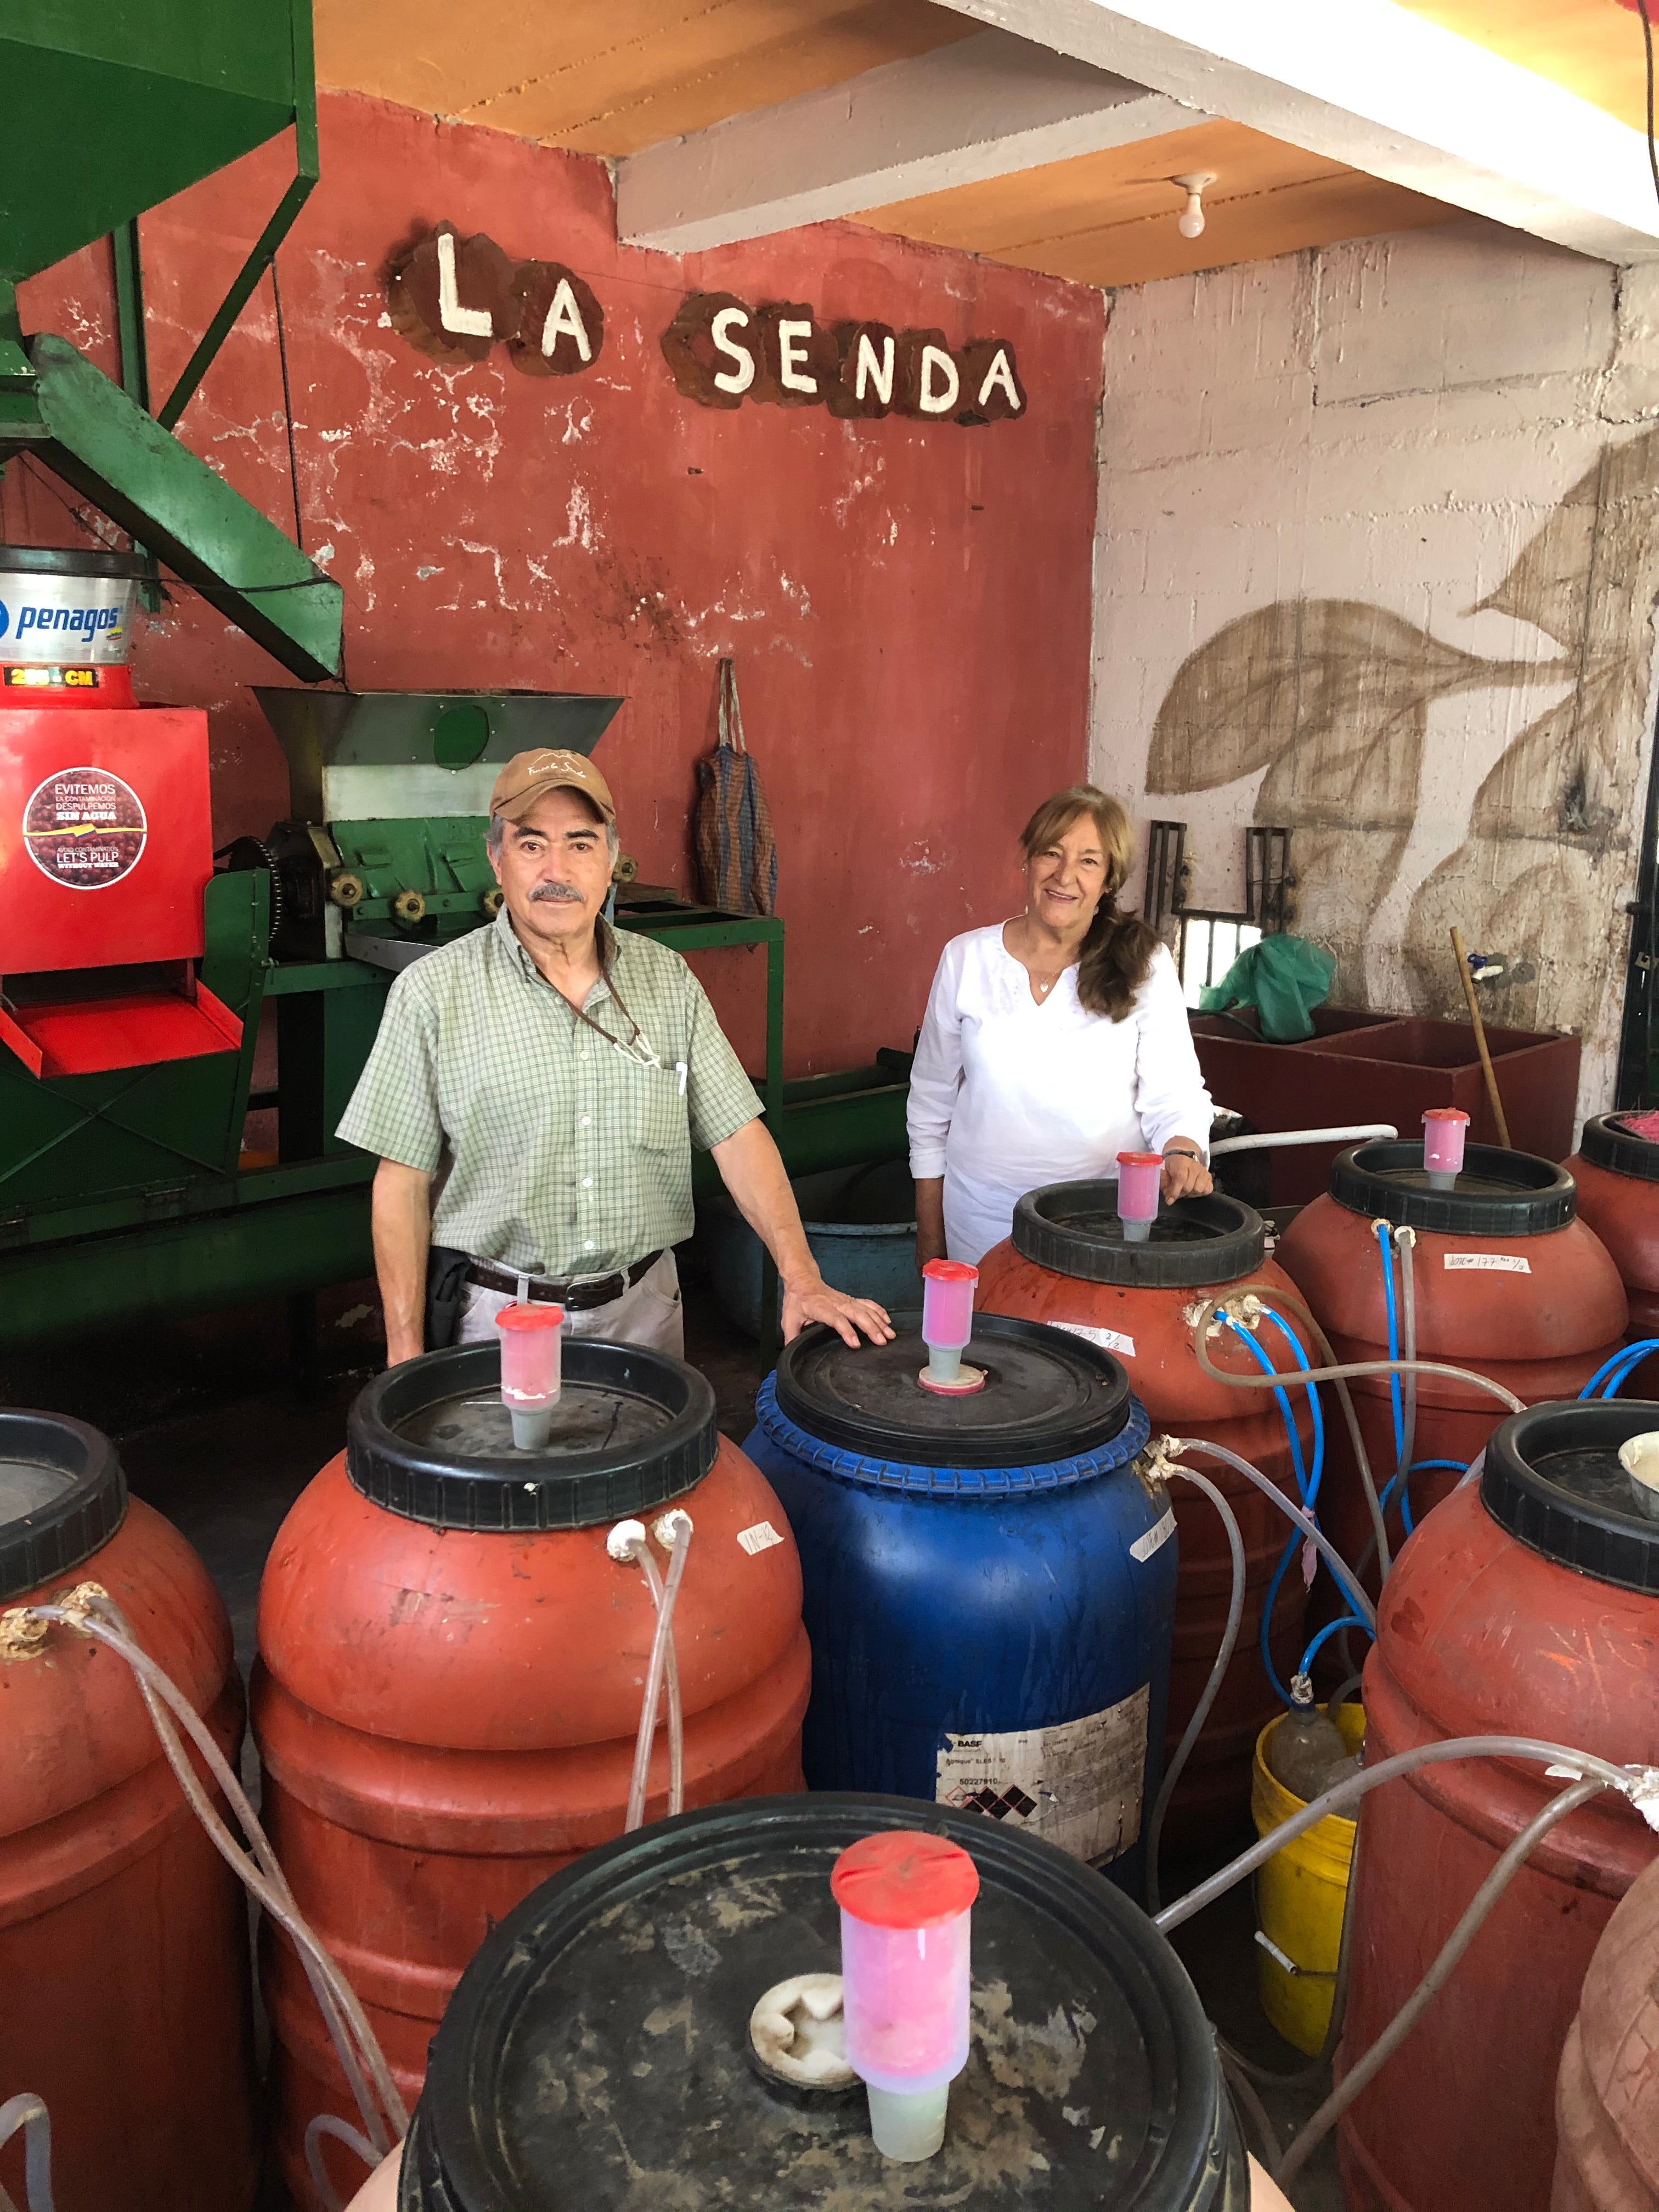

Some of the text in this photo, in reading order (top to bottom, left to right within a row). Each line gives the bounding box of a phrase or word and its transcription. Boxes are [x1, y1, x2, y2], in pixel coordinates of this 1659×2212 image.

[438, 233, 1022, 413] LA SENDA
[15, 606, 119, 642] penagos
[55, 784, 116, 794] EVITEMOS
[57, 811, 117, 820] SIN AGUA
[57, 851, 119, 862] LET'S PULP
[1477, 1256, 1497, 1267] 177
[1105, 1333, 1120, 1349] 2/2
